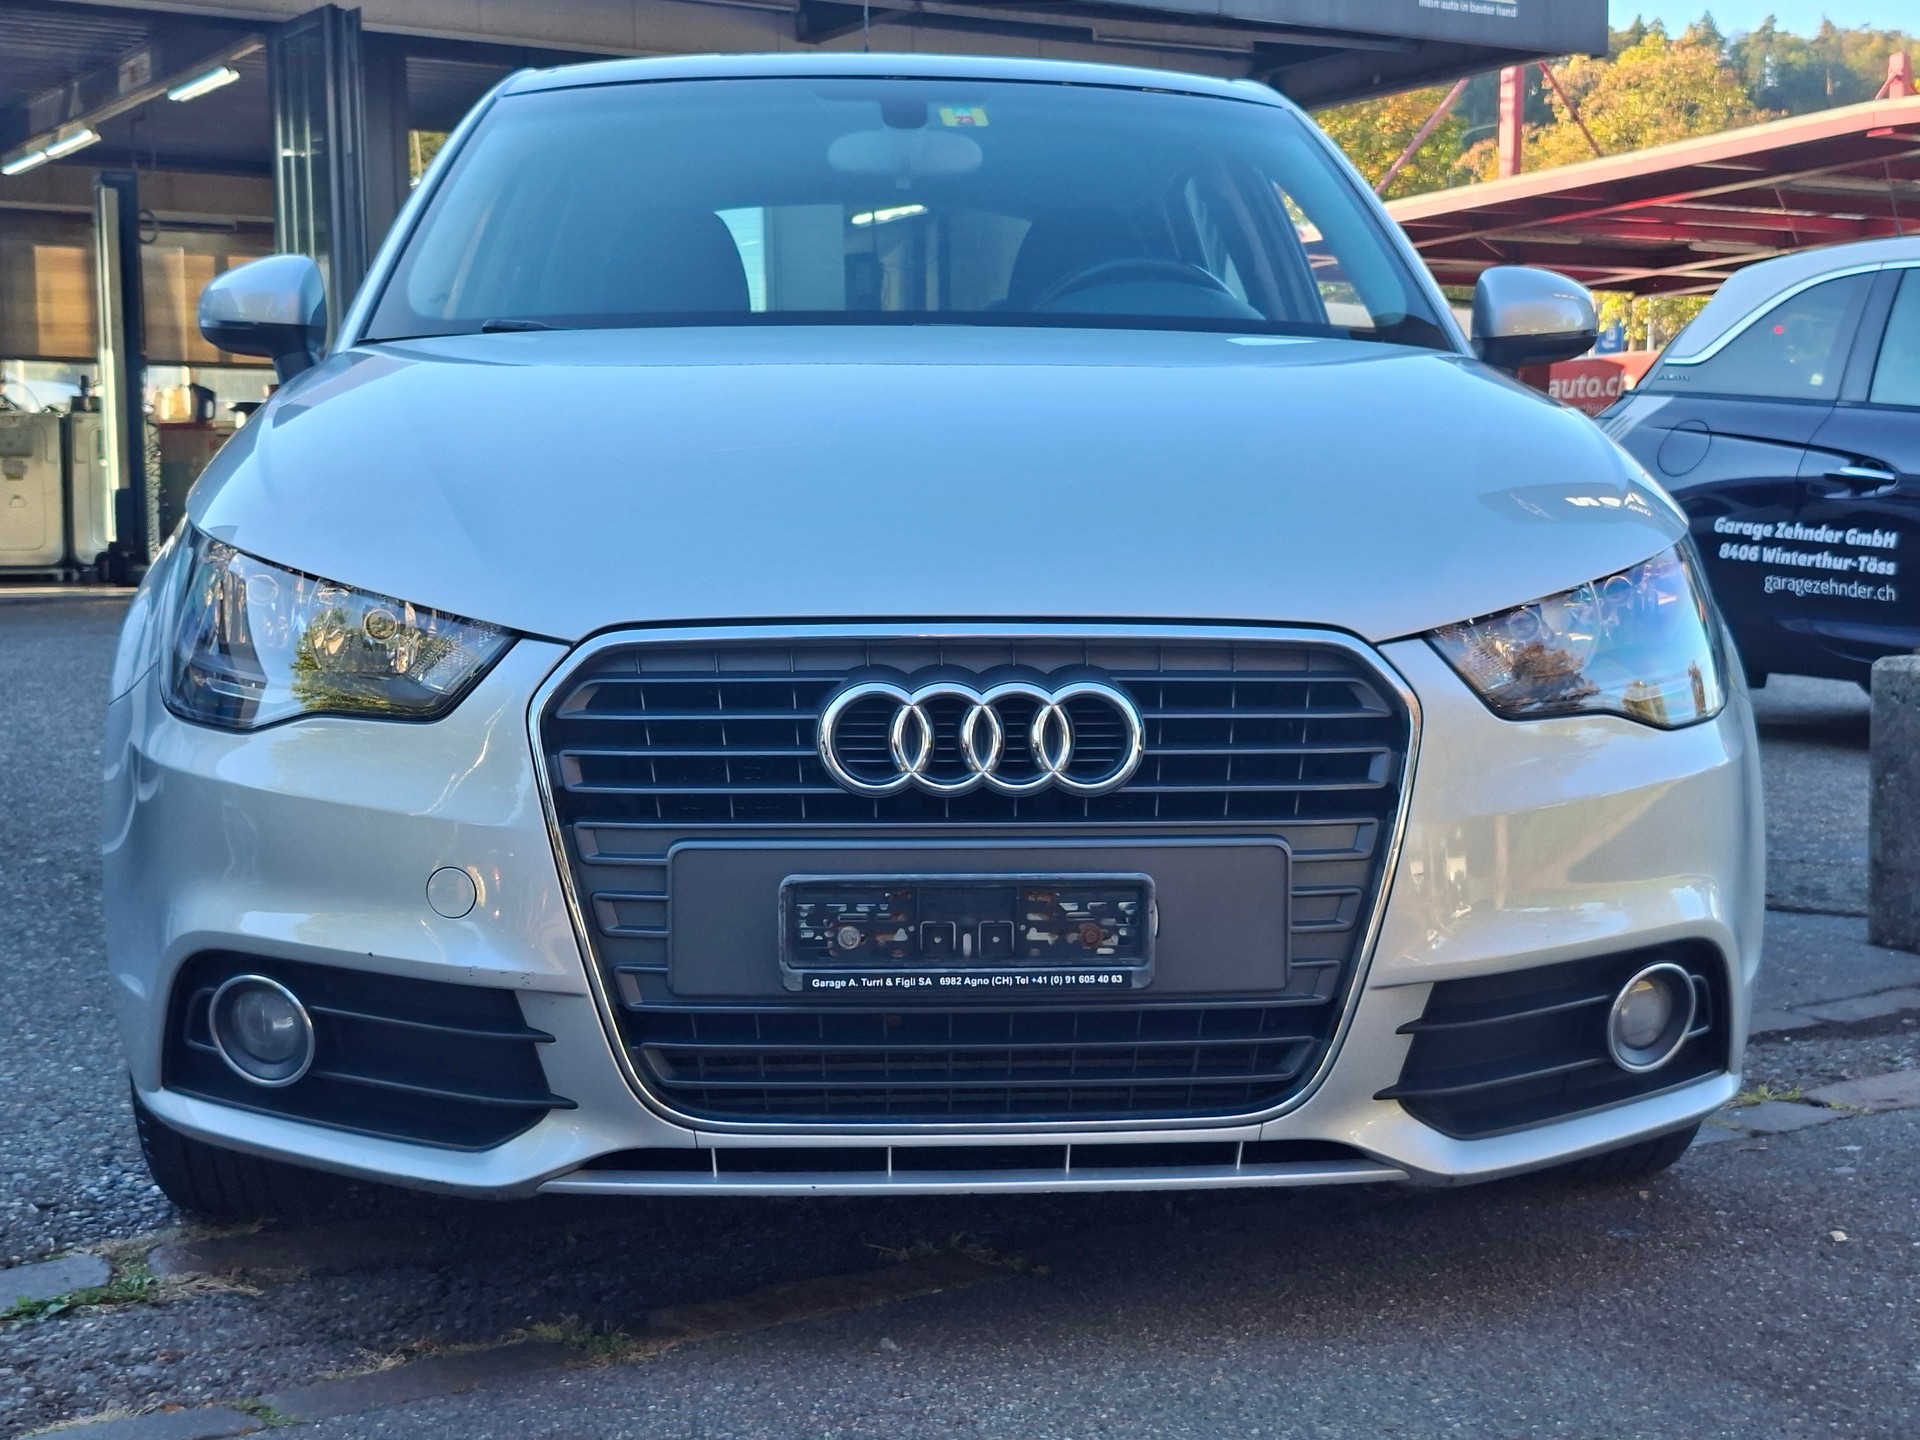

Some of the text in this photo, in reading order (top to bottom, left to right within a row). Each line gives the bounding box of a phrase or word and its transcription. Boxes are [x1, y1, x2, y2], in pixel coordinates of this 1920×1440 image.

[1440, 0, 1459, 10] auto
[1460, 1, 1469, 11] in
[1469, 1, 1495, 15] bester
[1496, 4, 1517, 18] hand
[1713, 516, 1897, 549] Garage Zehnder GmbH
[1718, 542, 1897, 576] 8406 Winterthur-Töss
[1763, 574, 1896, 602] garagezehnder.ch
[812, 974, 1123, 989] Garage A. Turri & Figli SA 6982 Agno (CH) Tel +41 (0) 91 605 40 63
